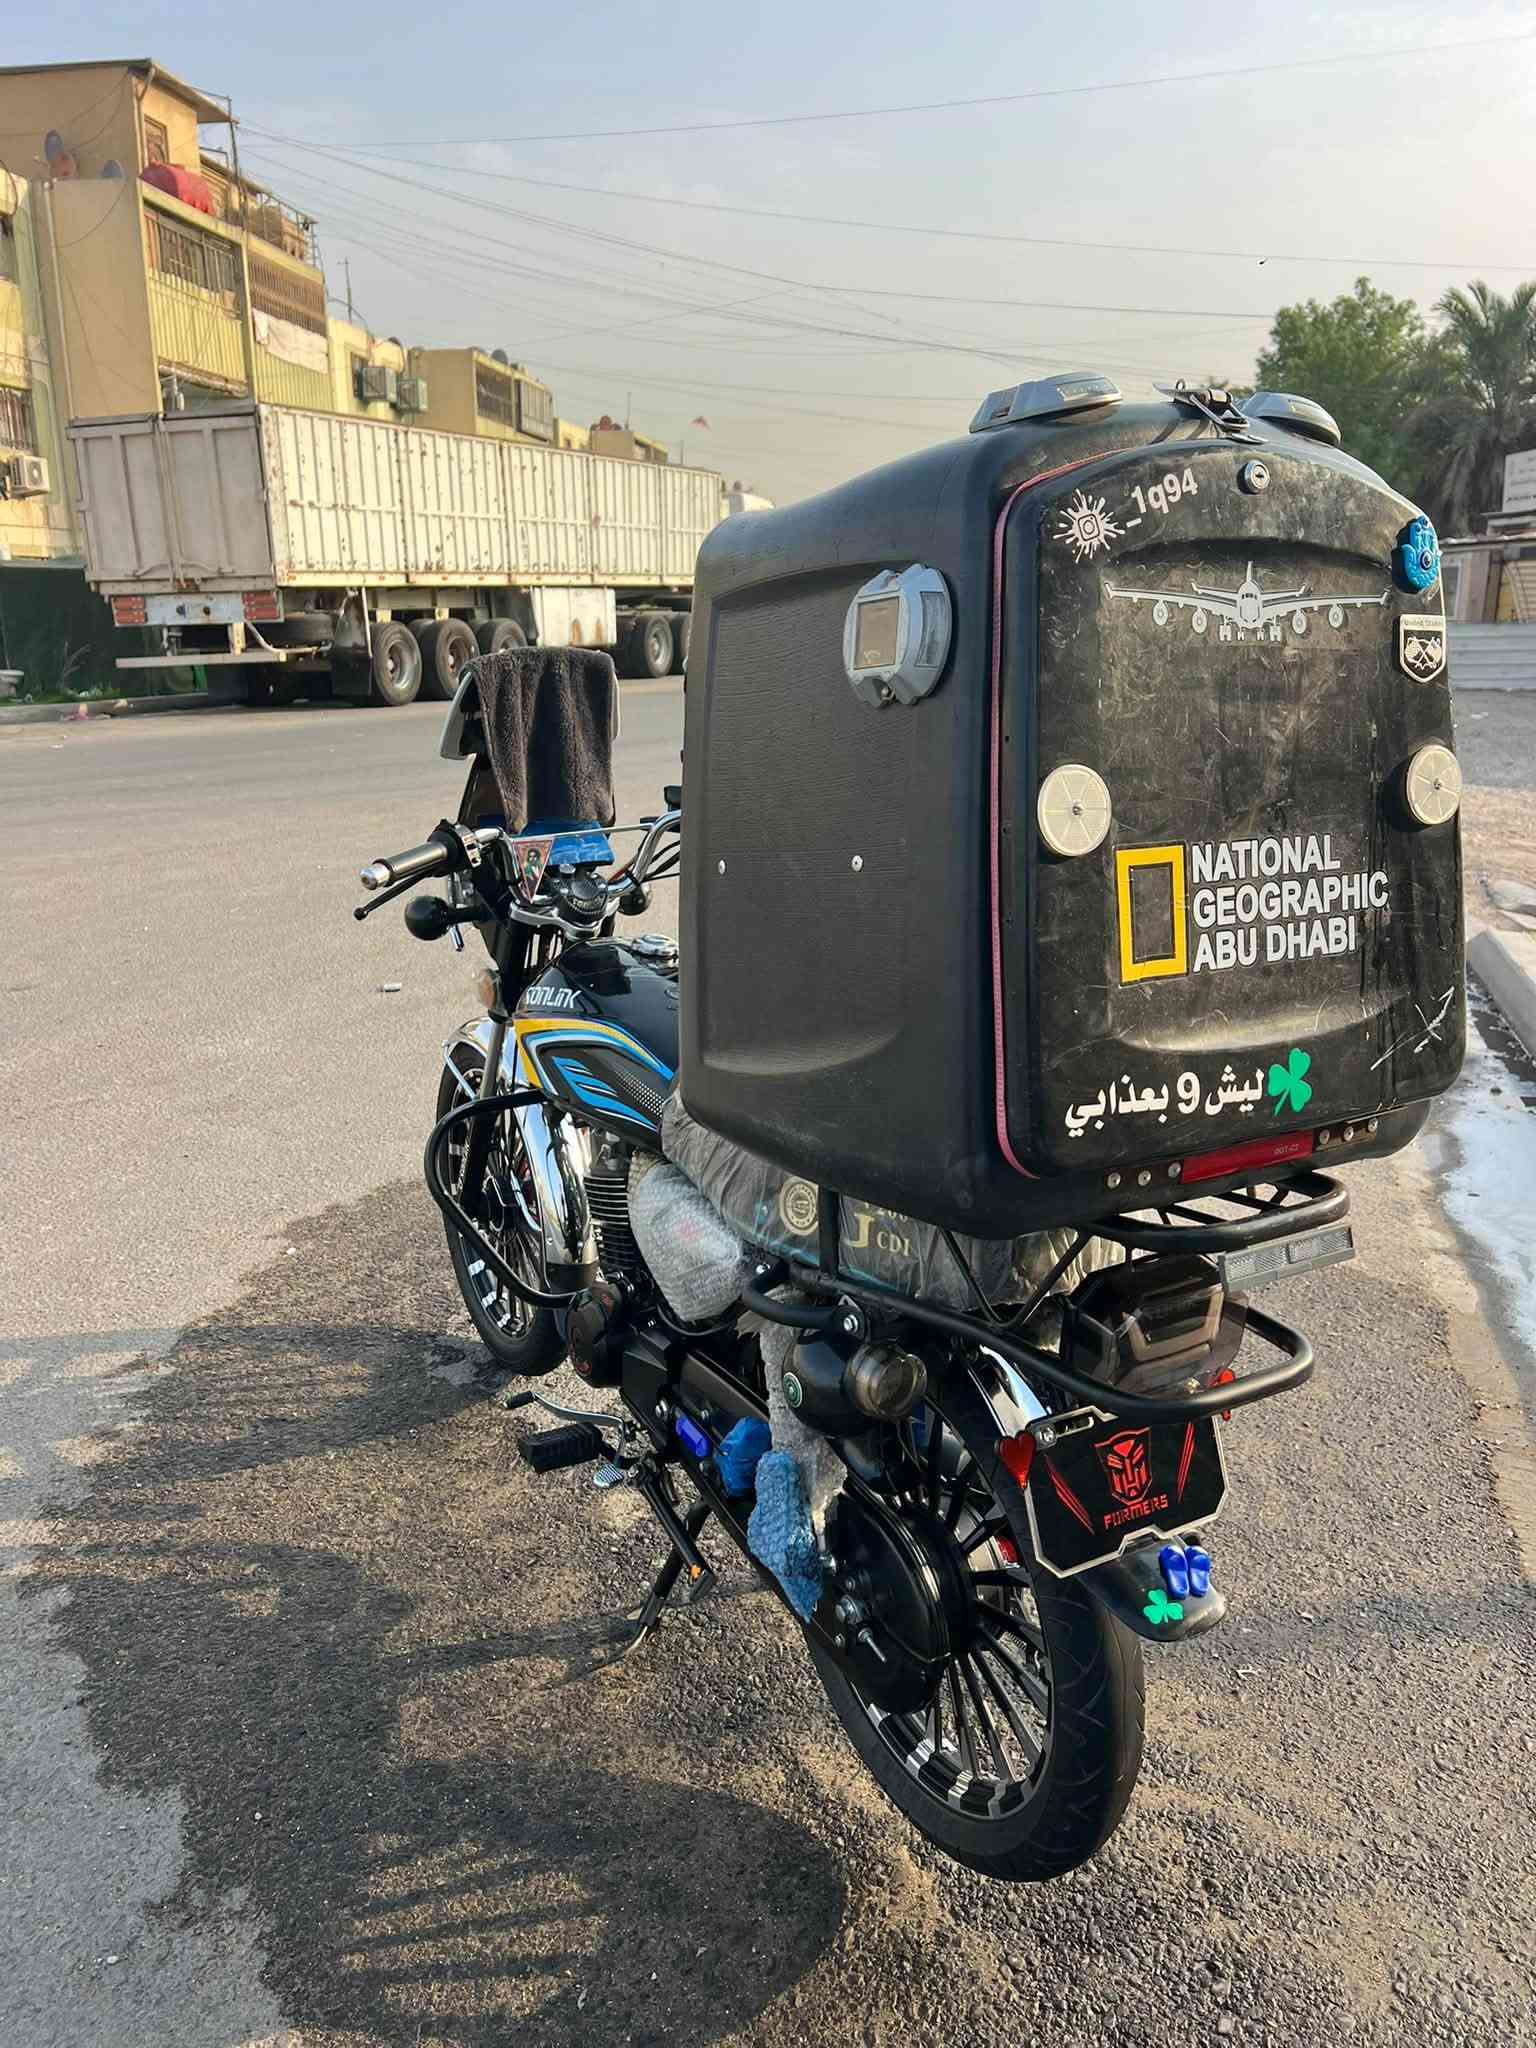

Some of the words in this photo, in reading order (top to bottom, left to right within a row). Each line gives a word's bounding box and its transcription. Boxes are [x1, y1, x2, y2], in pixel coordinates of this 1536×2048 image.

[1192, 834, 1341, 883] NATIONAL
[1193, 870, 1389, 928] GEOGRAPHIC
[1193, 927, 1257, 973] ABU
[1266, 915, 1356, 962] DHABI
[1065, 1074, 1169, 1138] بعذابي
[1176, 1071, 1200, 1115] 9
[1205, 1064, 1265, 1116] ليش
[877, 1231, 912, 1257] CDI
